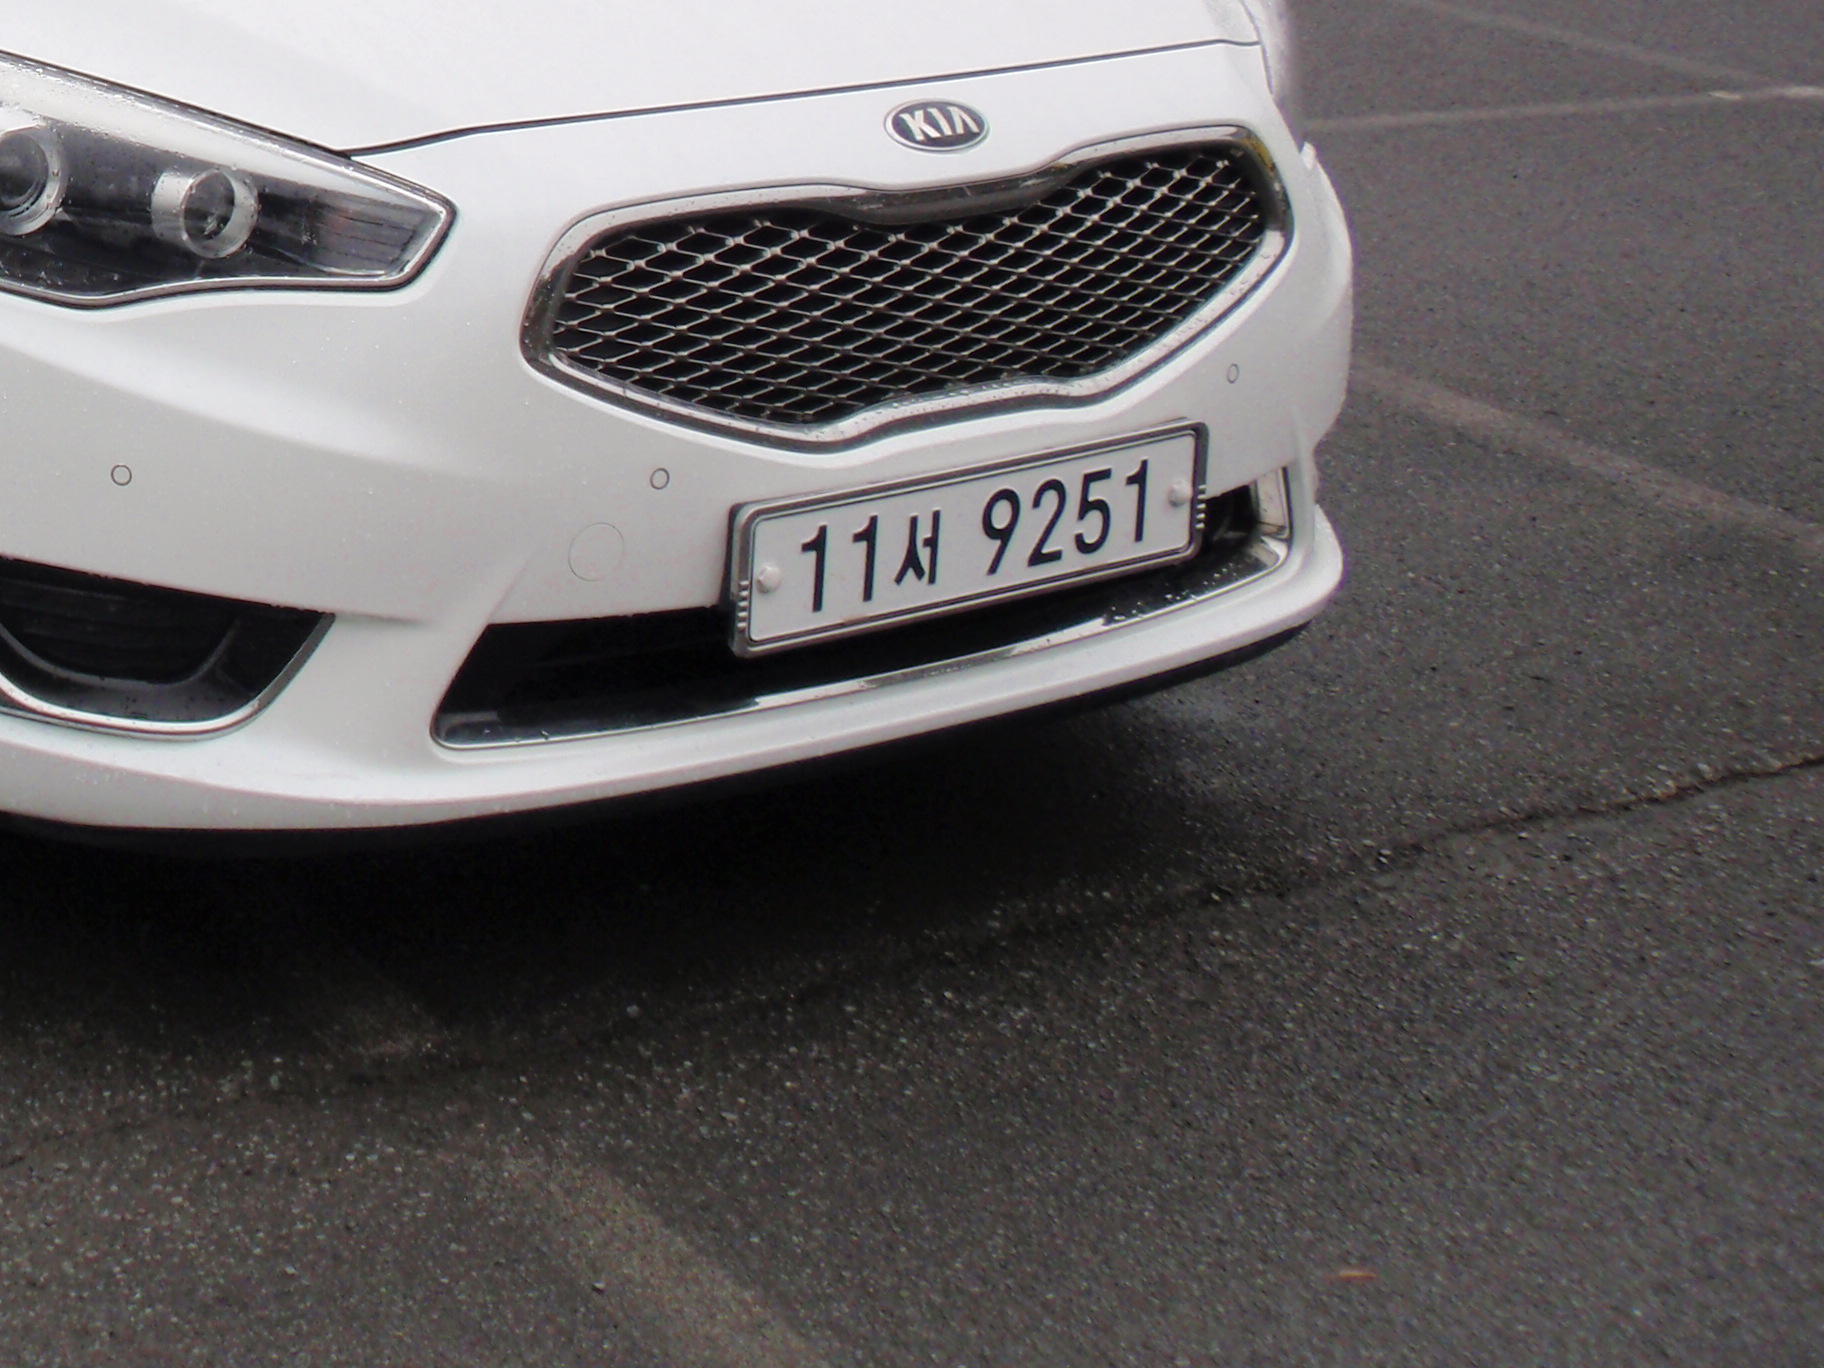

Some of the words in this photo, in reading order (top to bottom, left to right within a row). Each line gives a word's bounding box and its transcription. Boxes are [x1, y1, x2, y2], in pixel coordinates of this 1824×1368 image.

[898, 106, 980, 141] KIA
[800, 509, 941, 612] 11서
[981, 459, 1149, 576] 9251
